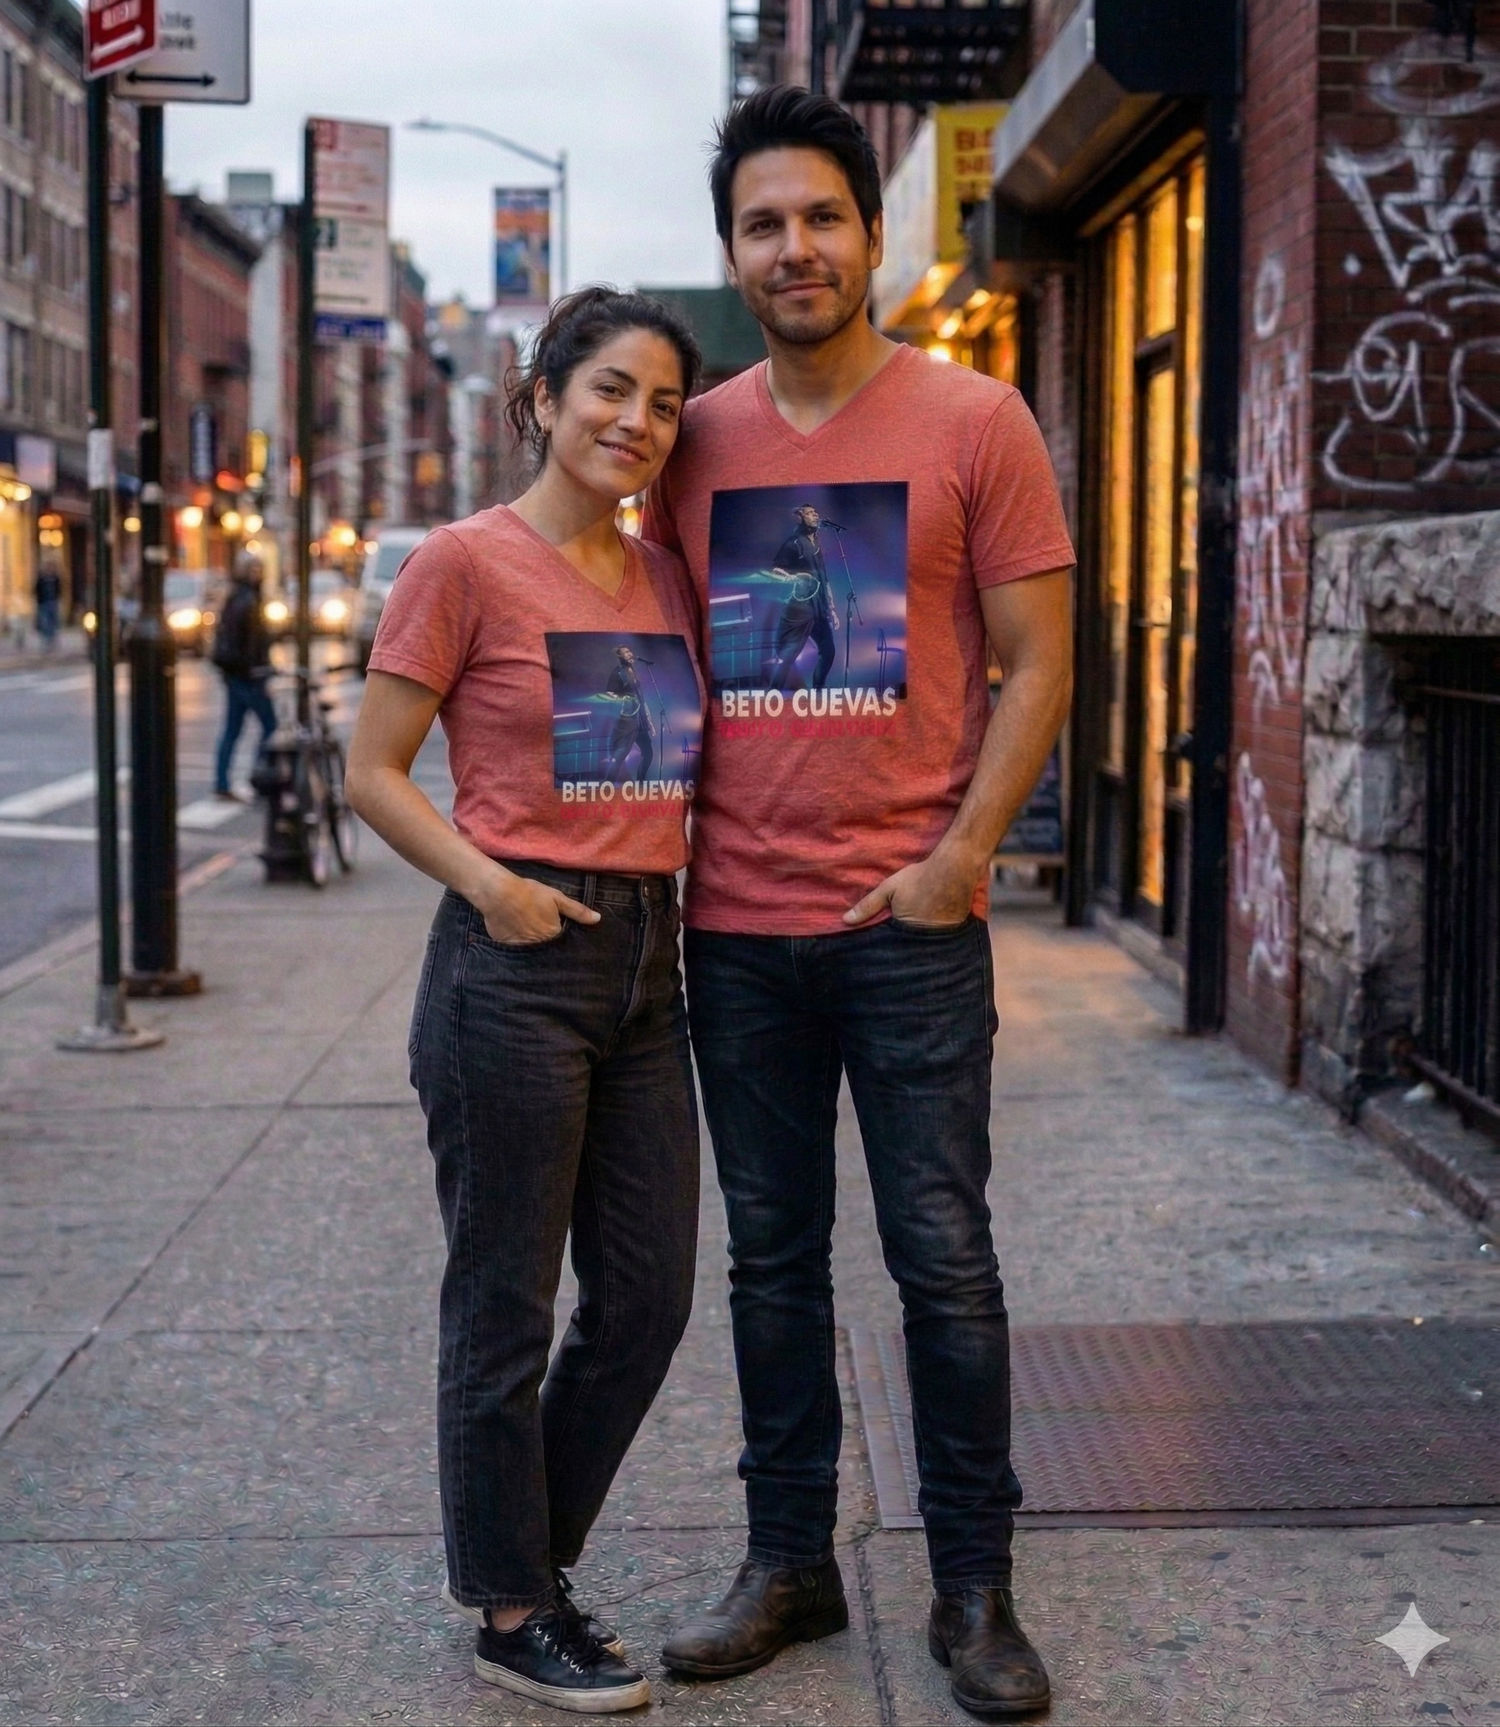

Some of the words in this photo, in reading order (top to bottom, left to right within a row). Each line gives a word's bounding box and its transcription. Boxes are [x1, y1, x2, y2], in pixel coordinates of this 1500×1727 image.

[722, 689, 784, 717] BETO
[792, 687, 897, 717] CUEVAS
[562, 781, 615, 802] BETO
[622, 780, 695, 802] CUEVAS
